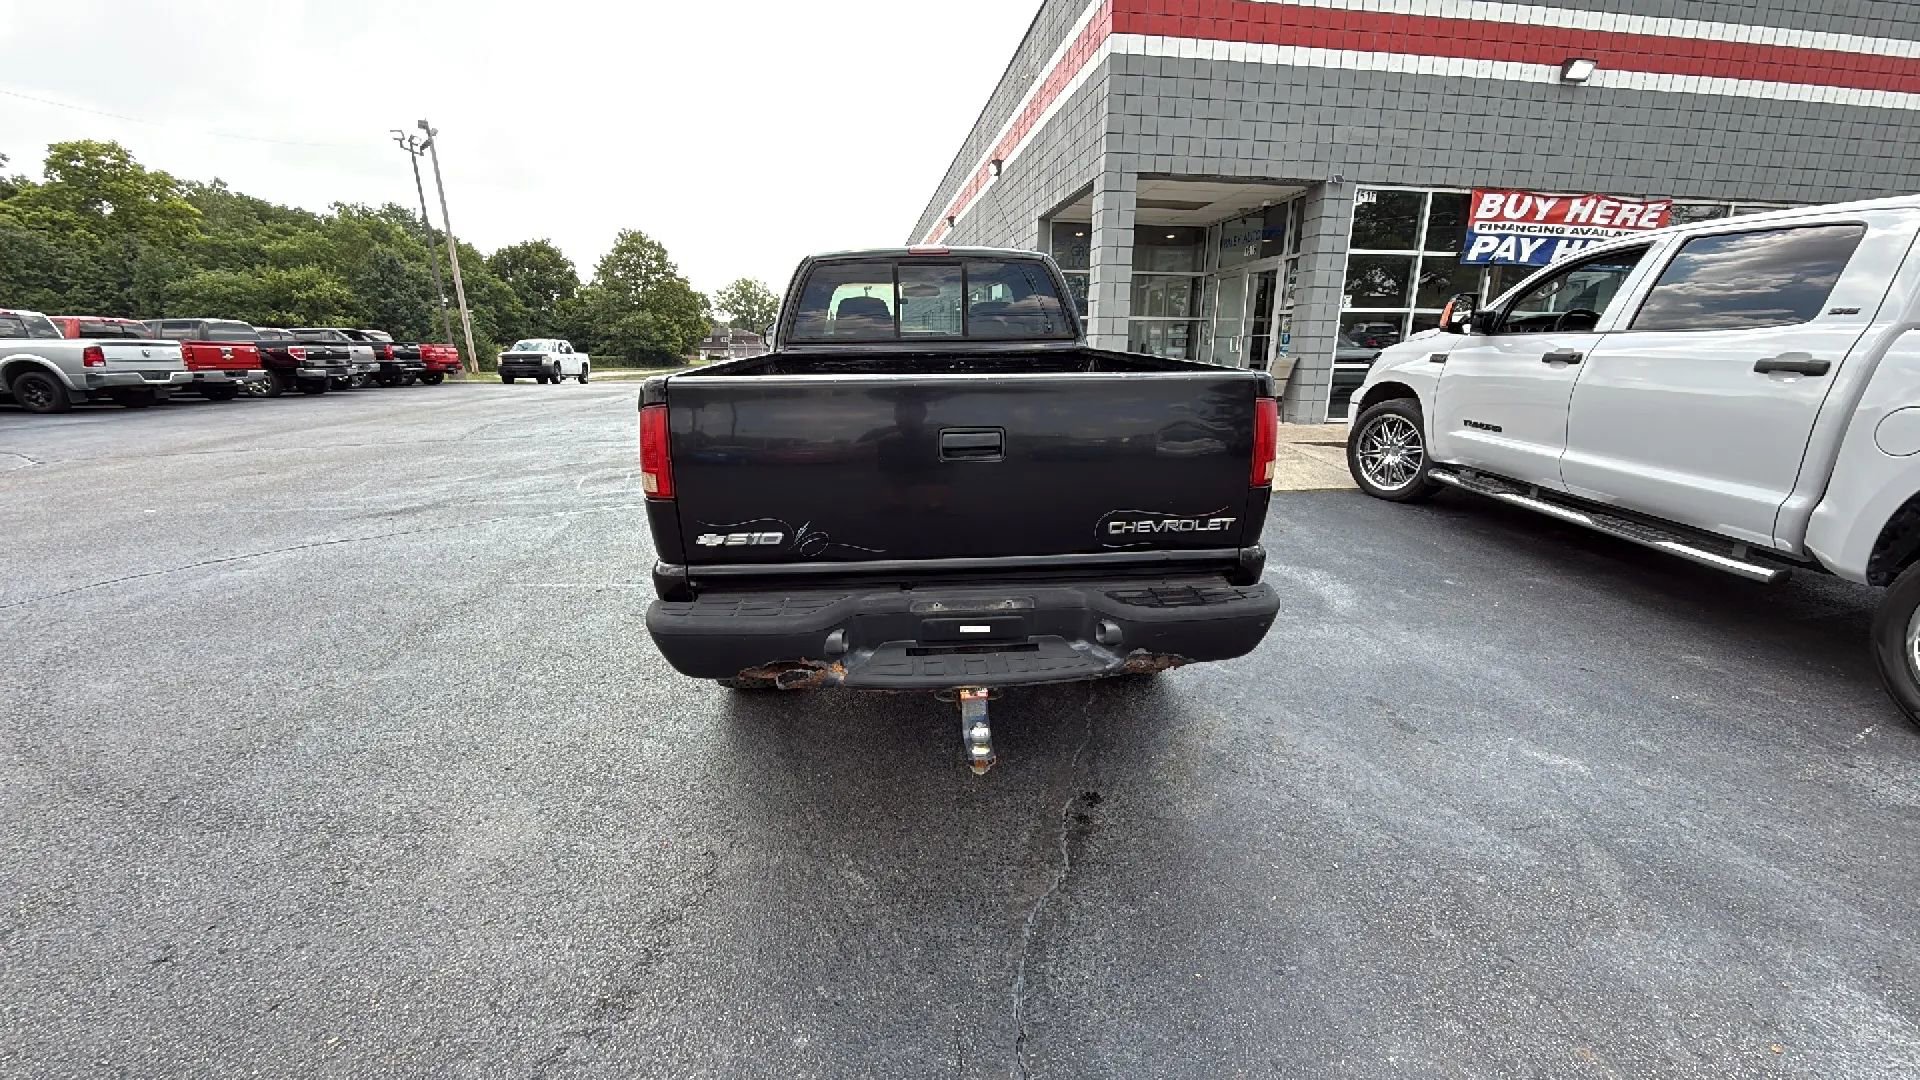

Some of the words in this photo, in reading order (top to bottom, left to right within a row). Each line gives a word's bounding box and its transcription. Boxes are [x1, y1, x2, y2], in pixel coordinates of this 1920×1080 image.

[1474, 193, 1558, 221] BUY
[1564, 198, 1667, 228] HERE
[1478, 223, 1565, 235] FINANCING
[1466, 235, 1548, 263] PAY
[1108, 517, 1237, 535] CHEVROLET
[724, 531, 784, 547] S10
